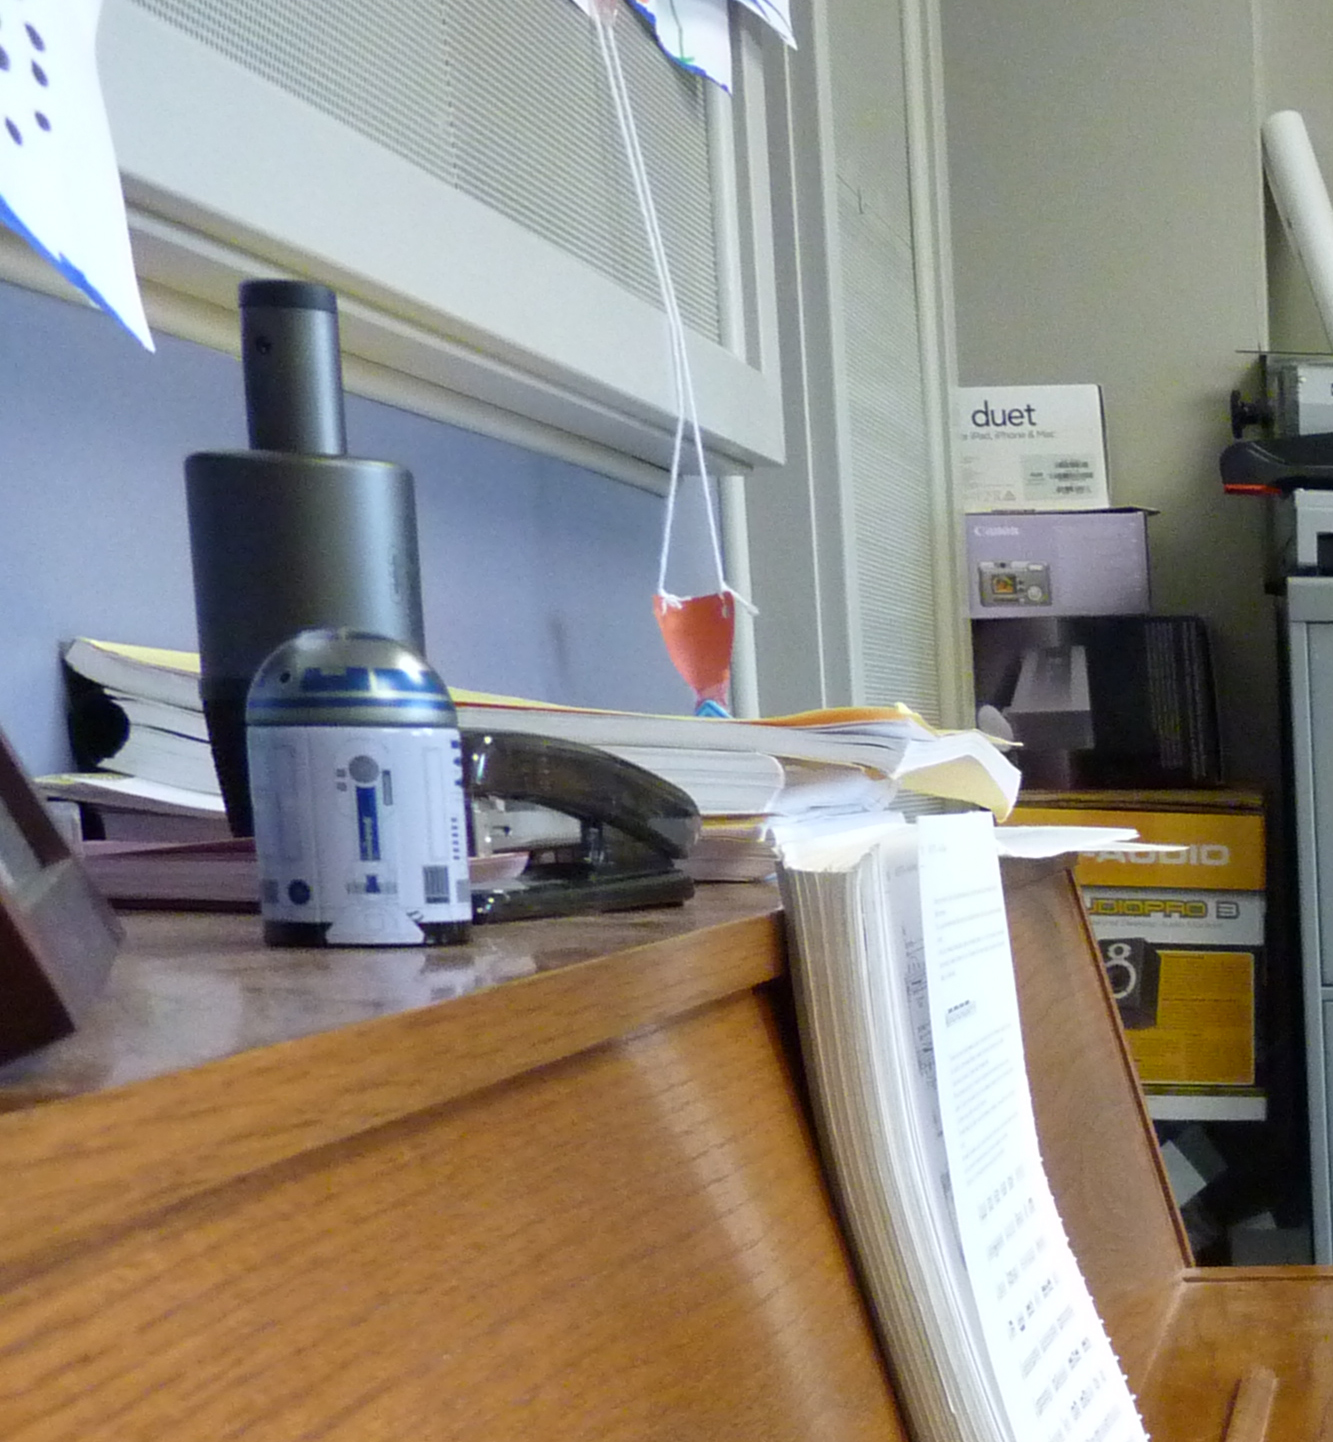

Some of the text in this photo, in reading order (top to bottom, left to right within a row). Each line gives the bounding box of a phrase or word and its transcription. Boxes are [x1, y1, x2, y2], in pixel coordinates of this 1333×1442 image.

[971, 400, 1037, 427] duet
[994, 431, 1026, 440] iPhone
[1036, 430, 1055, 438] Mac
[1216, 900, 1240, 919] 3
